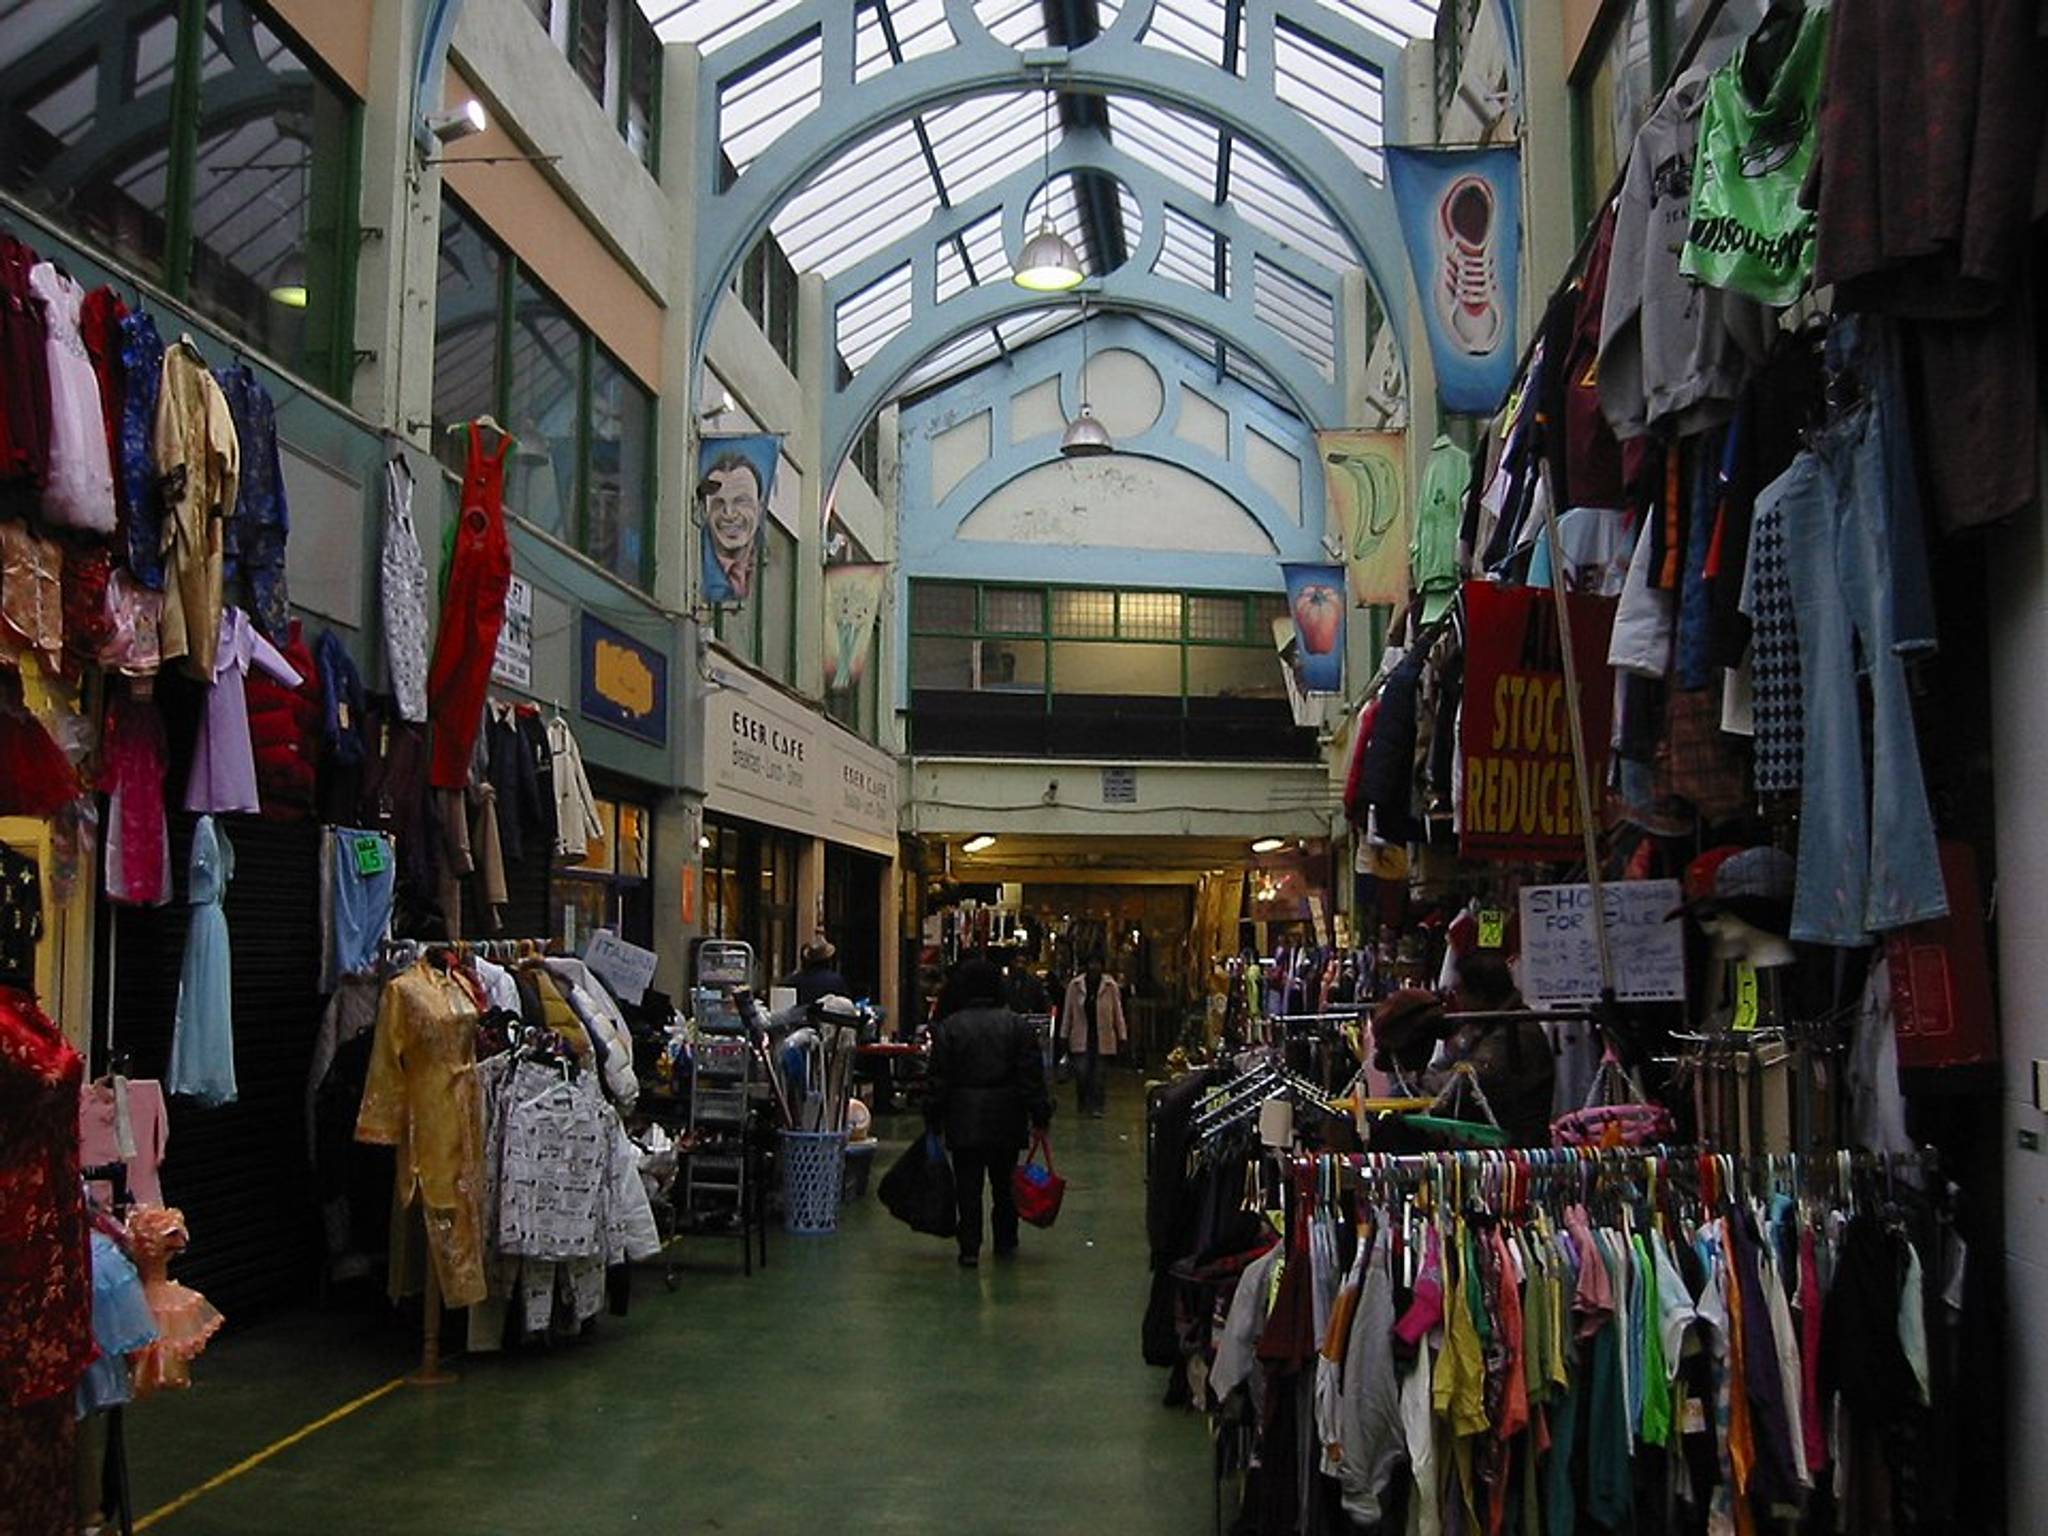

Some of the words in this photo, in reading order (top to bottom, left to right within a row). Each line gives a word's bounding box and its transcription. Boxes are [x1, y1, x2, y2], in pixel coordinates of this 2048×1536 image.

[732, 711, 767, 746] ESER
[772, 730, 805, 762] CAFE
[1529, 886, 1624, 914] SHOS
[1545, 912, 1585, 933] FOR
